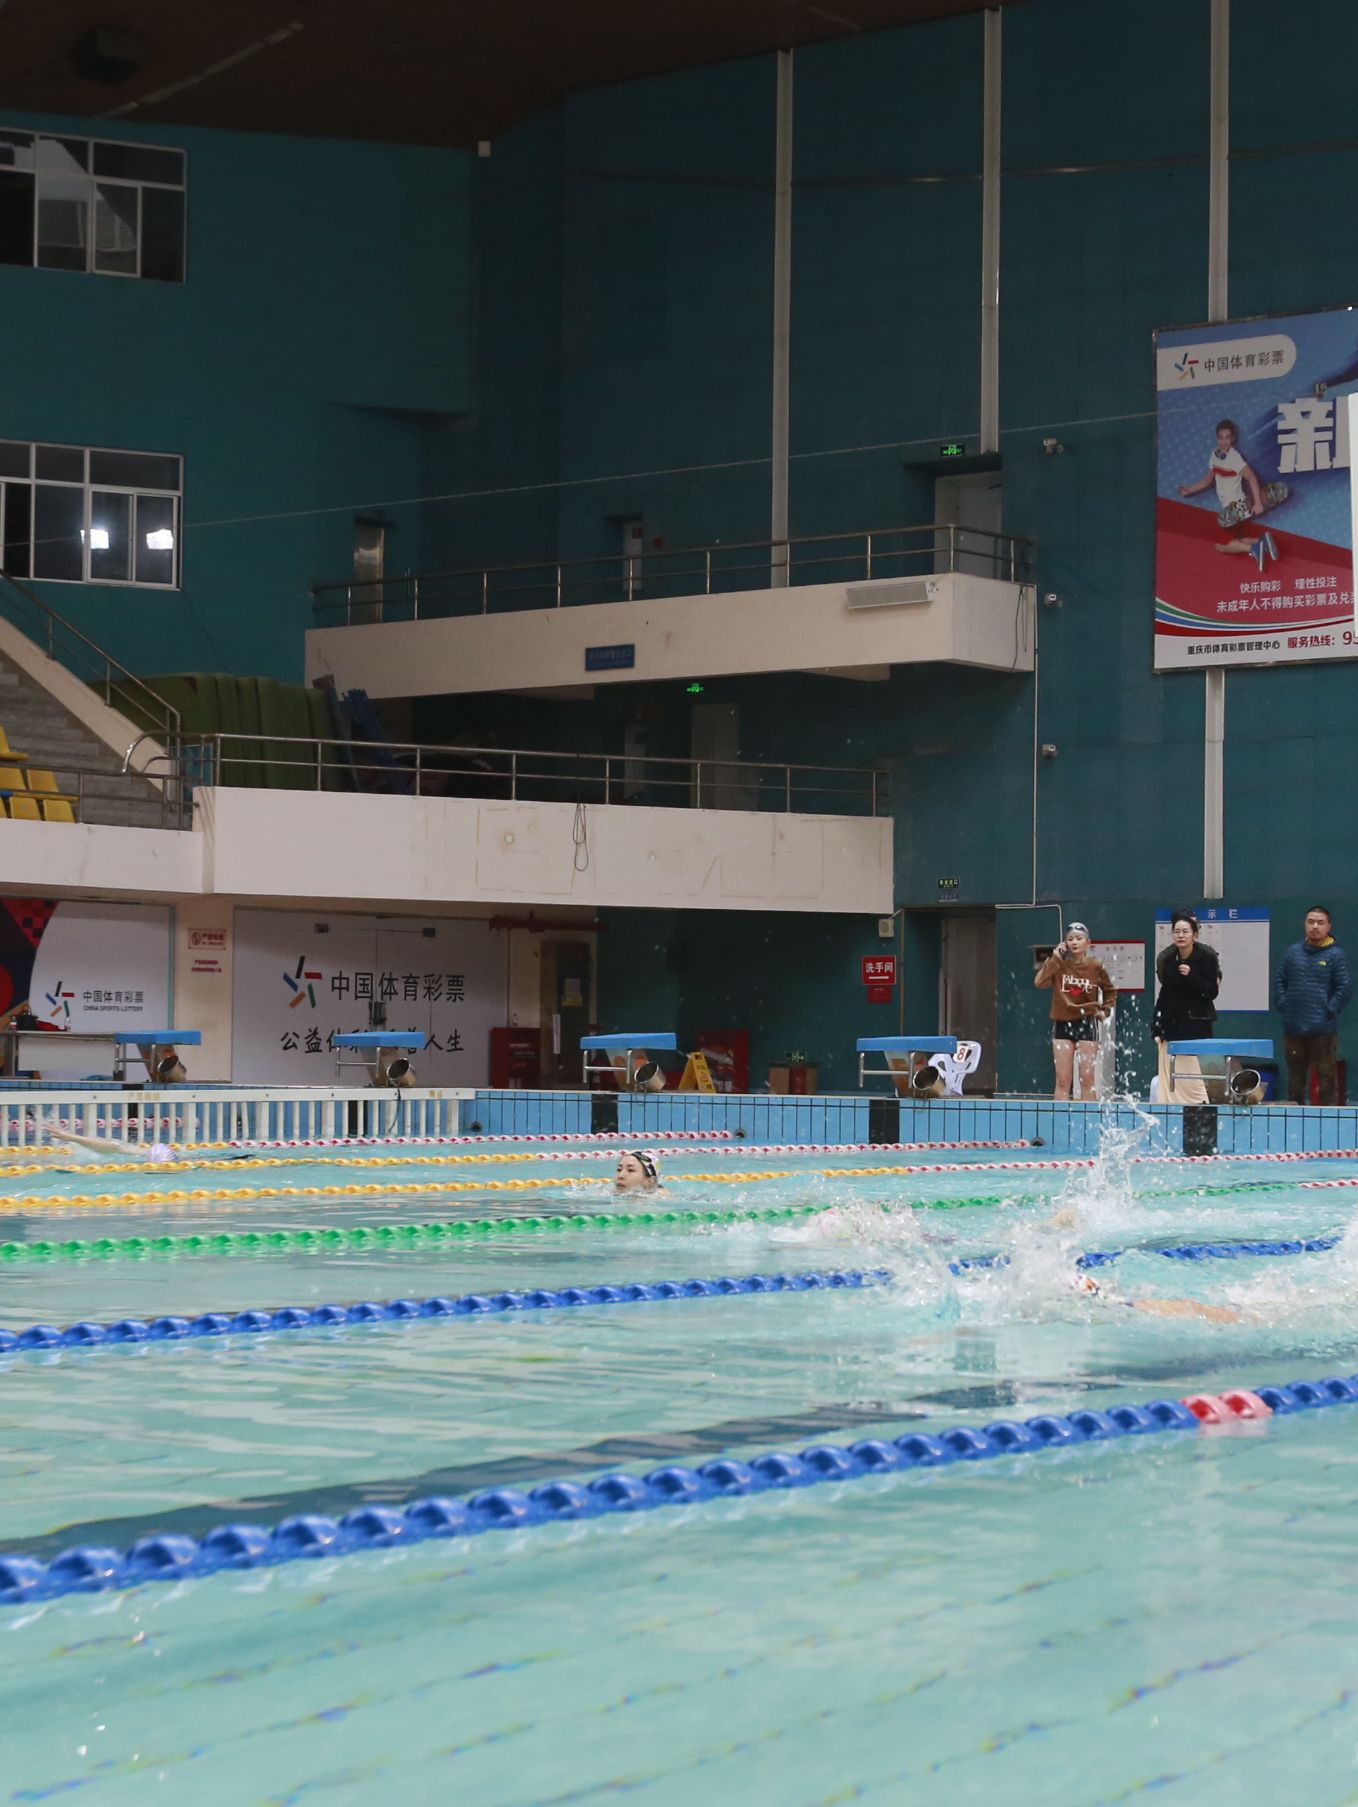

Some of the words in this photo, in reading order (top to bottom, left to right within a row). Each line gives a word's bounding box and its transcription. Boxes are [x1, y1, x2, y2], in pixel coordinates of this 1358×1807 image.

[1204, 350, 1284, 373] 中国体育彩票
[1240, 580, 1281, 593] 快乐购彩
[1295, 576, 1337, 590] 理性投注
[1187, 640, 1280, 655] 重庆市体育彩票管理中心
[866, 962, 894, 974] 洗手间
[331, 970, 465, 1003] 中国体育彩票
[83, 990, 144, 1003] 中国体育彩票
[957, 1048, 965, 1060] 8
